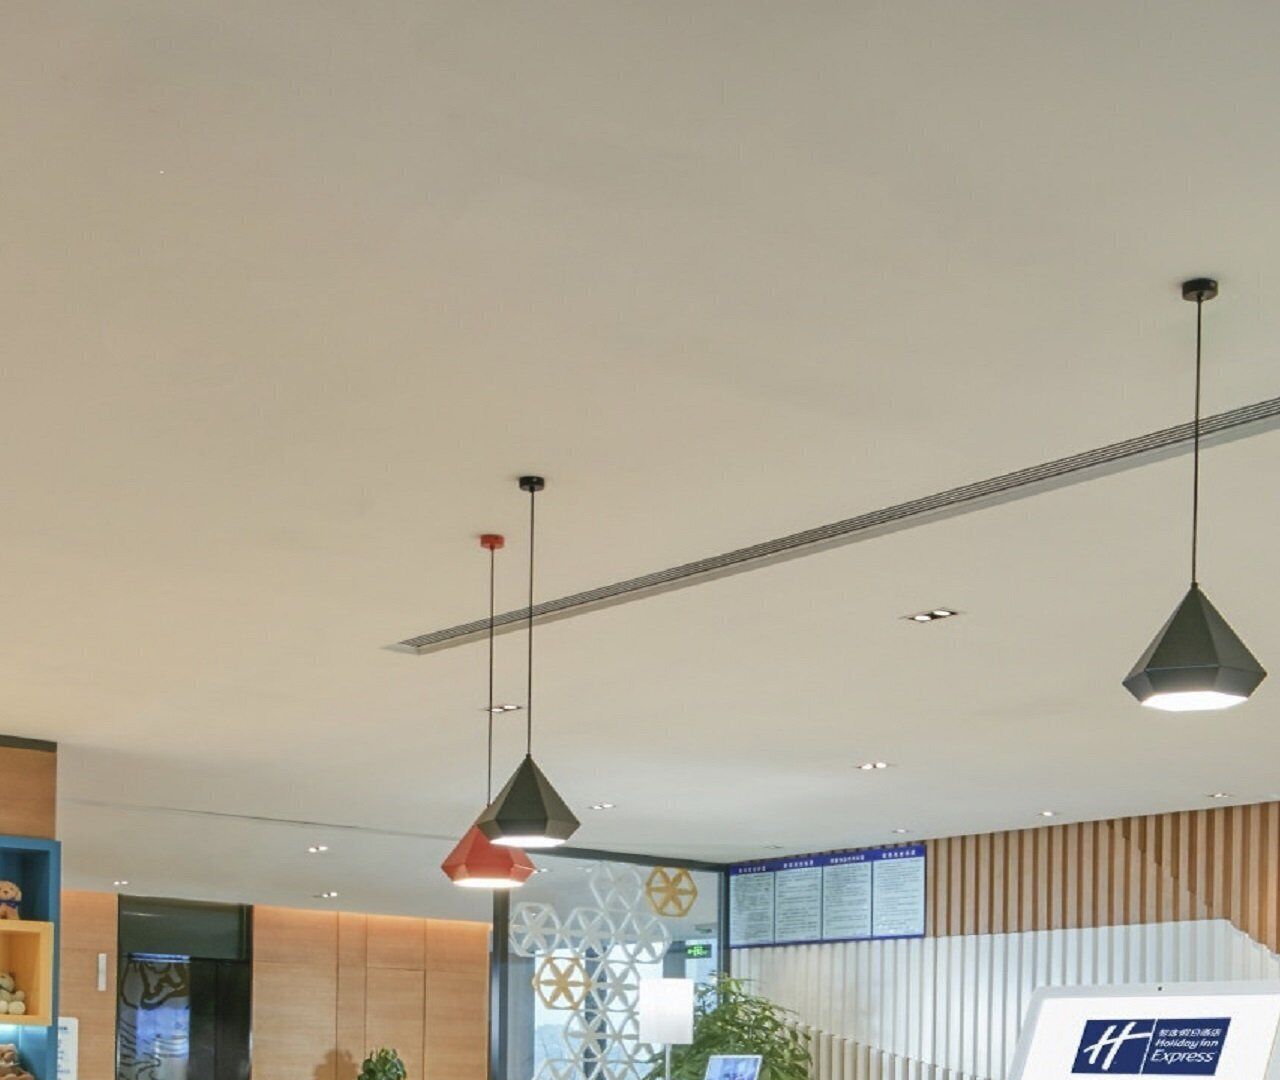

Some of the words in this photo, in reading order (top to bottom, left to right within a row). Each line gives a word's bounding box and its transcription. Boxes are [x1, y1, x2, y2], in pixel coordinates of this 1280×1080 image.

[1155, 1038, 1199, 1049] Holiday
[1199, 1038, 1219, 1047] Inn
[1150, 1049, 1215, 1064] Express
